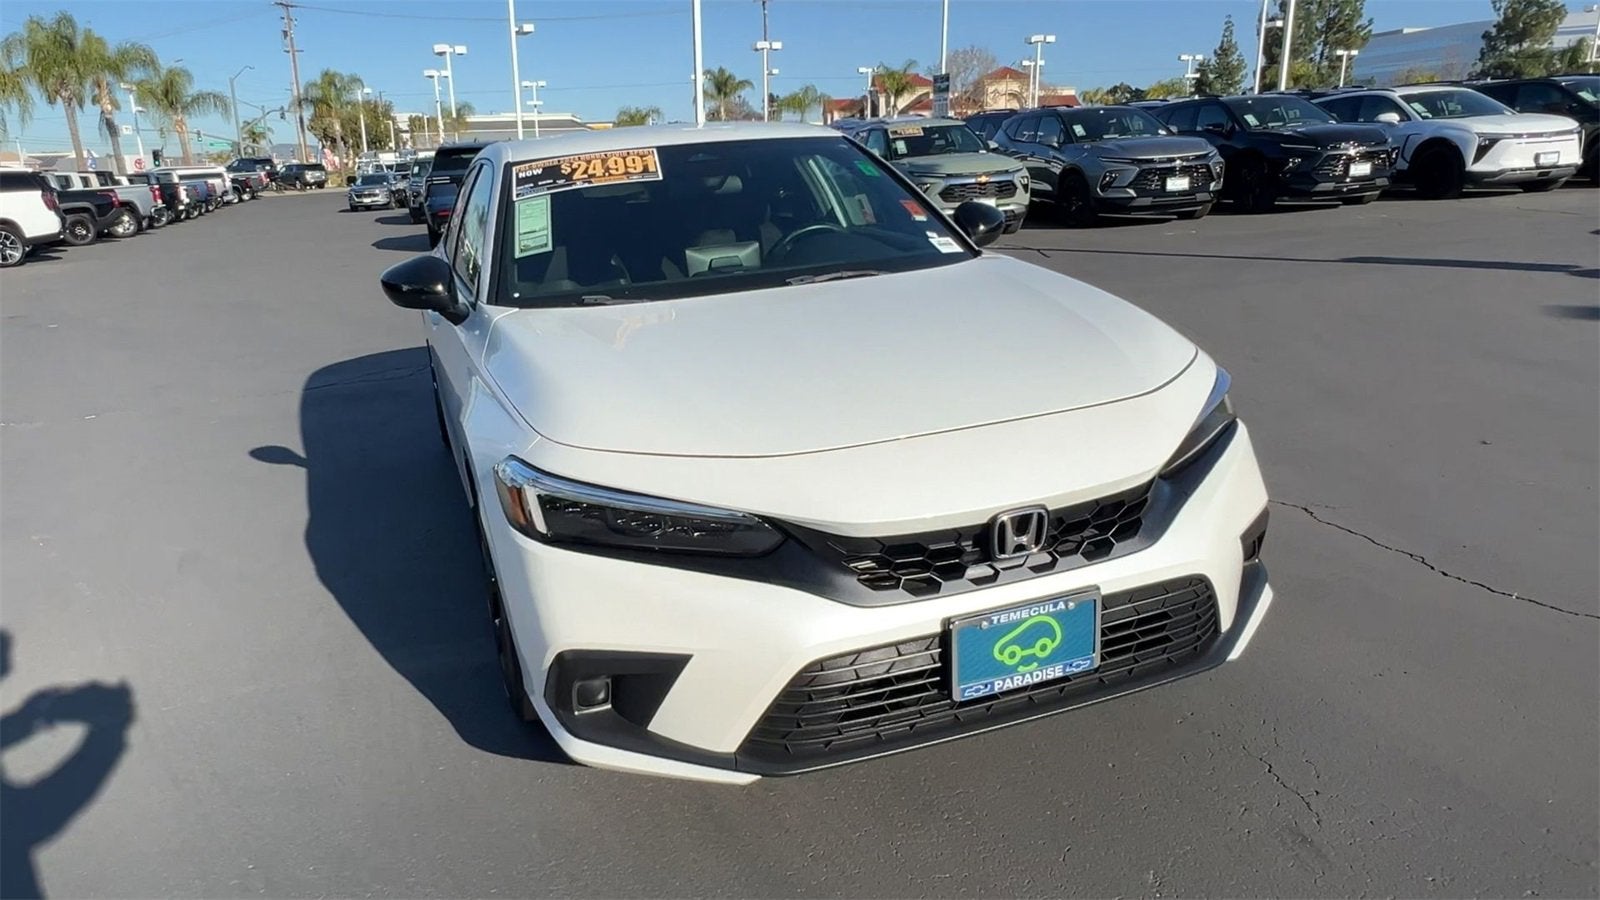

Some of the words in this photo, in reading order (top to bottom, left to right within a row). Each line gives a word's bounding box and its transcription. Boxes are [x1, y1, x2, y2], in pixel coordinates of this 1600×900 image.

[518, 168, 543, 179] NOW
[991, 601, 1066, 624] TEMECULA
[994, 665, 1064, 691] PARADISE
